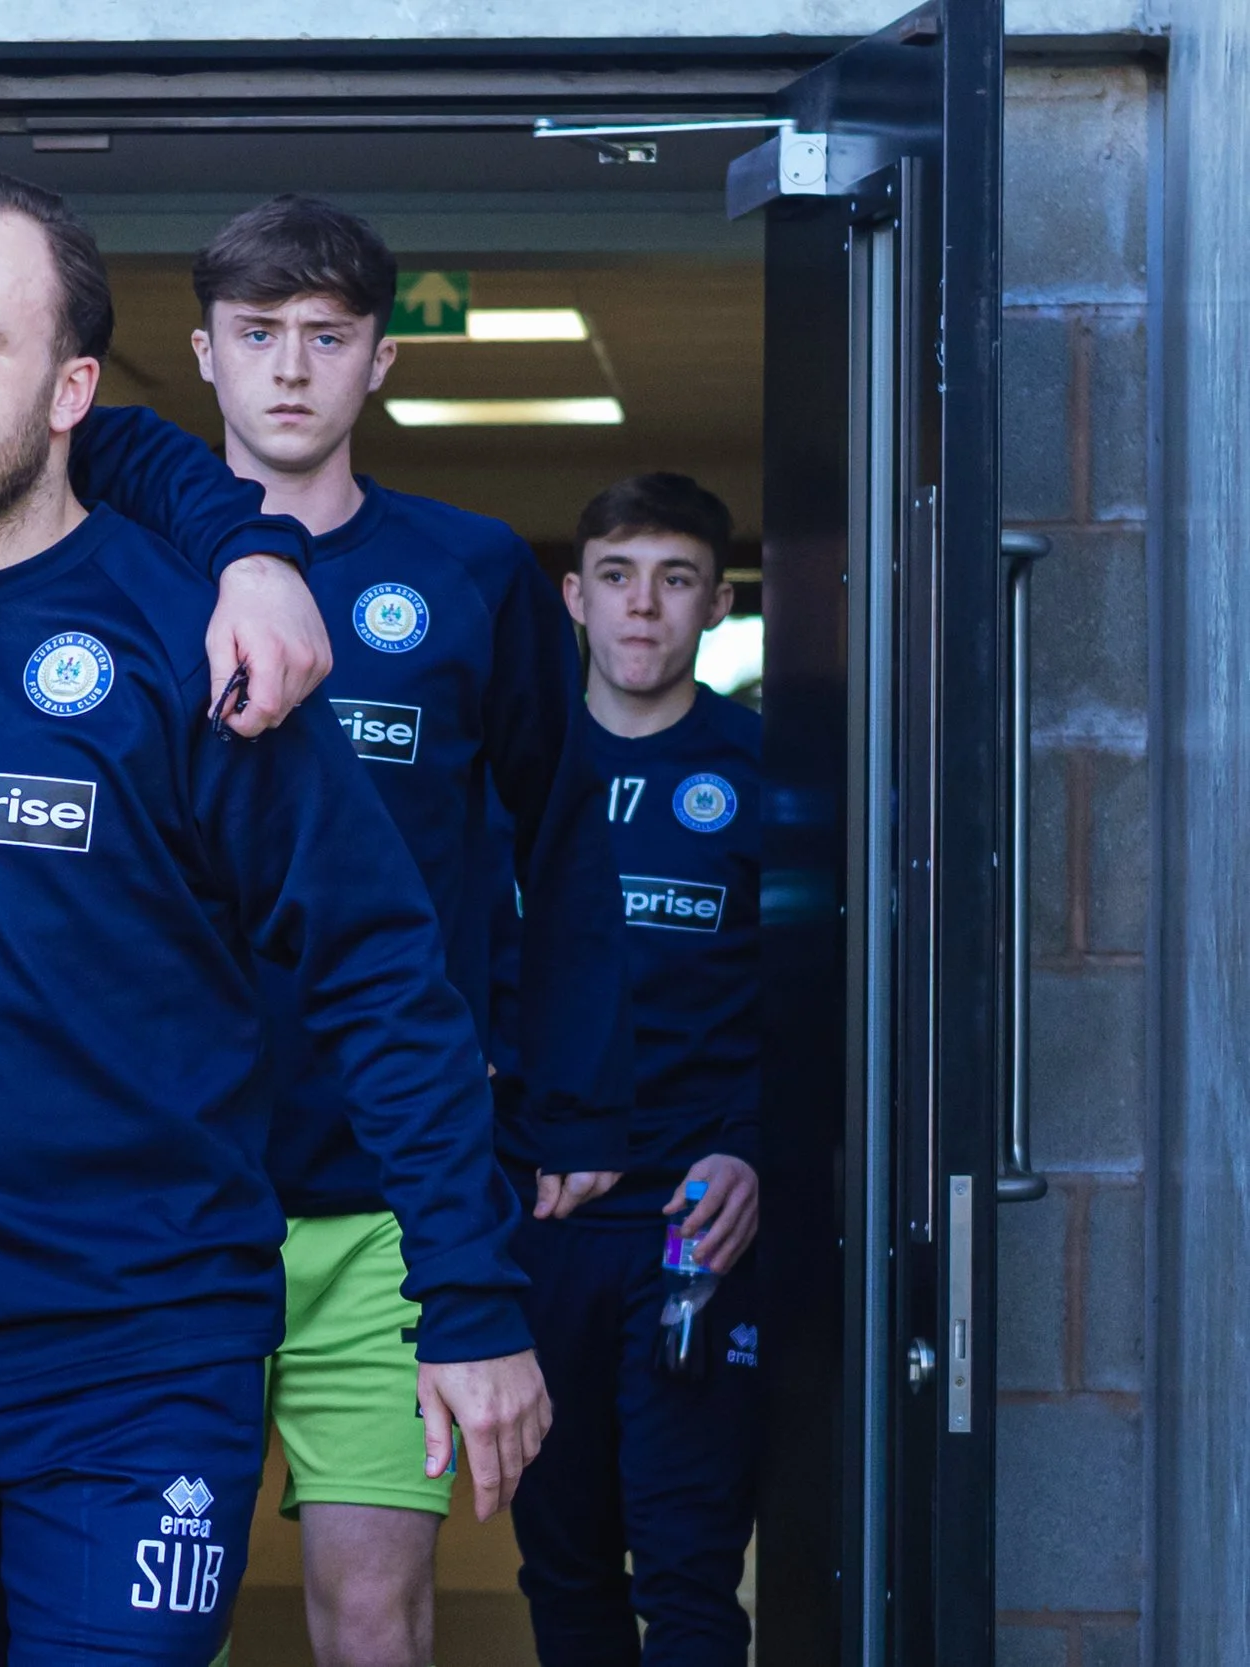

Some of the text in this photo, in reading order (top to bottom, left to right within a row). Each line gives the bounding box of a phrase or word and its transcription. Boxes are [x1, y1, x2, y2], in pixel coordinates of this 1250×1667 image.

[359, 586, 424, 615] CURZON ASHTON
[358, 623, 422, 650] FOOTBALL CLUB
[33, 635, 109, 671] CURZON ASHTON
[28, 681, 103, 713] FOOTBALL CLUB
[608, 778, 646, 823] 17
[622, 889, 717, 918] prise
[727, 1349, 757, 1367] erre
[131, 1539, 224, 1613] SUB
